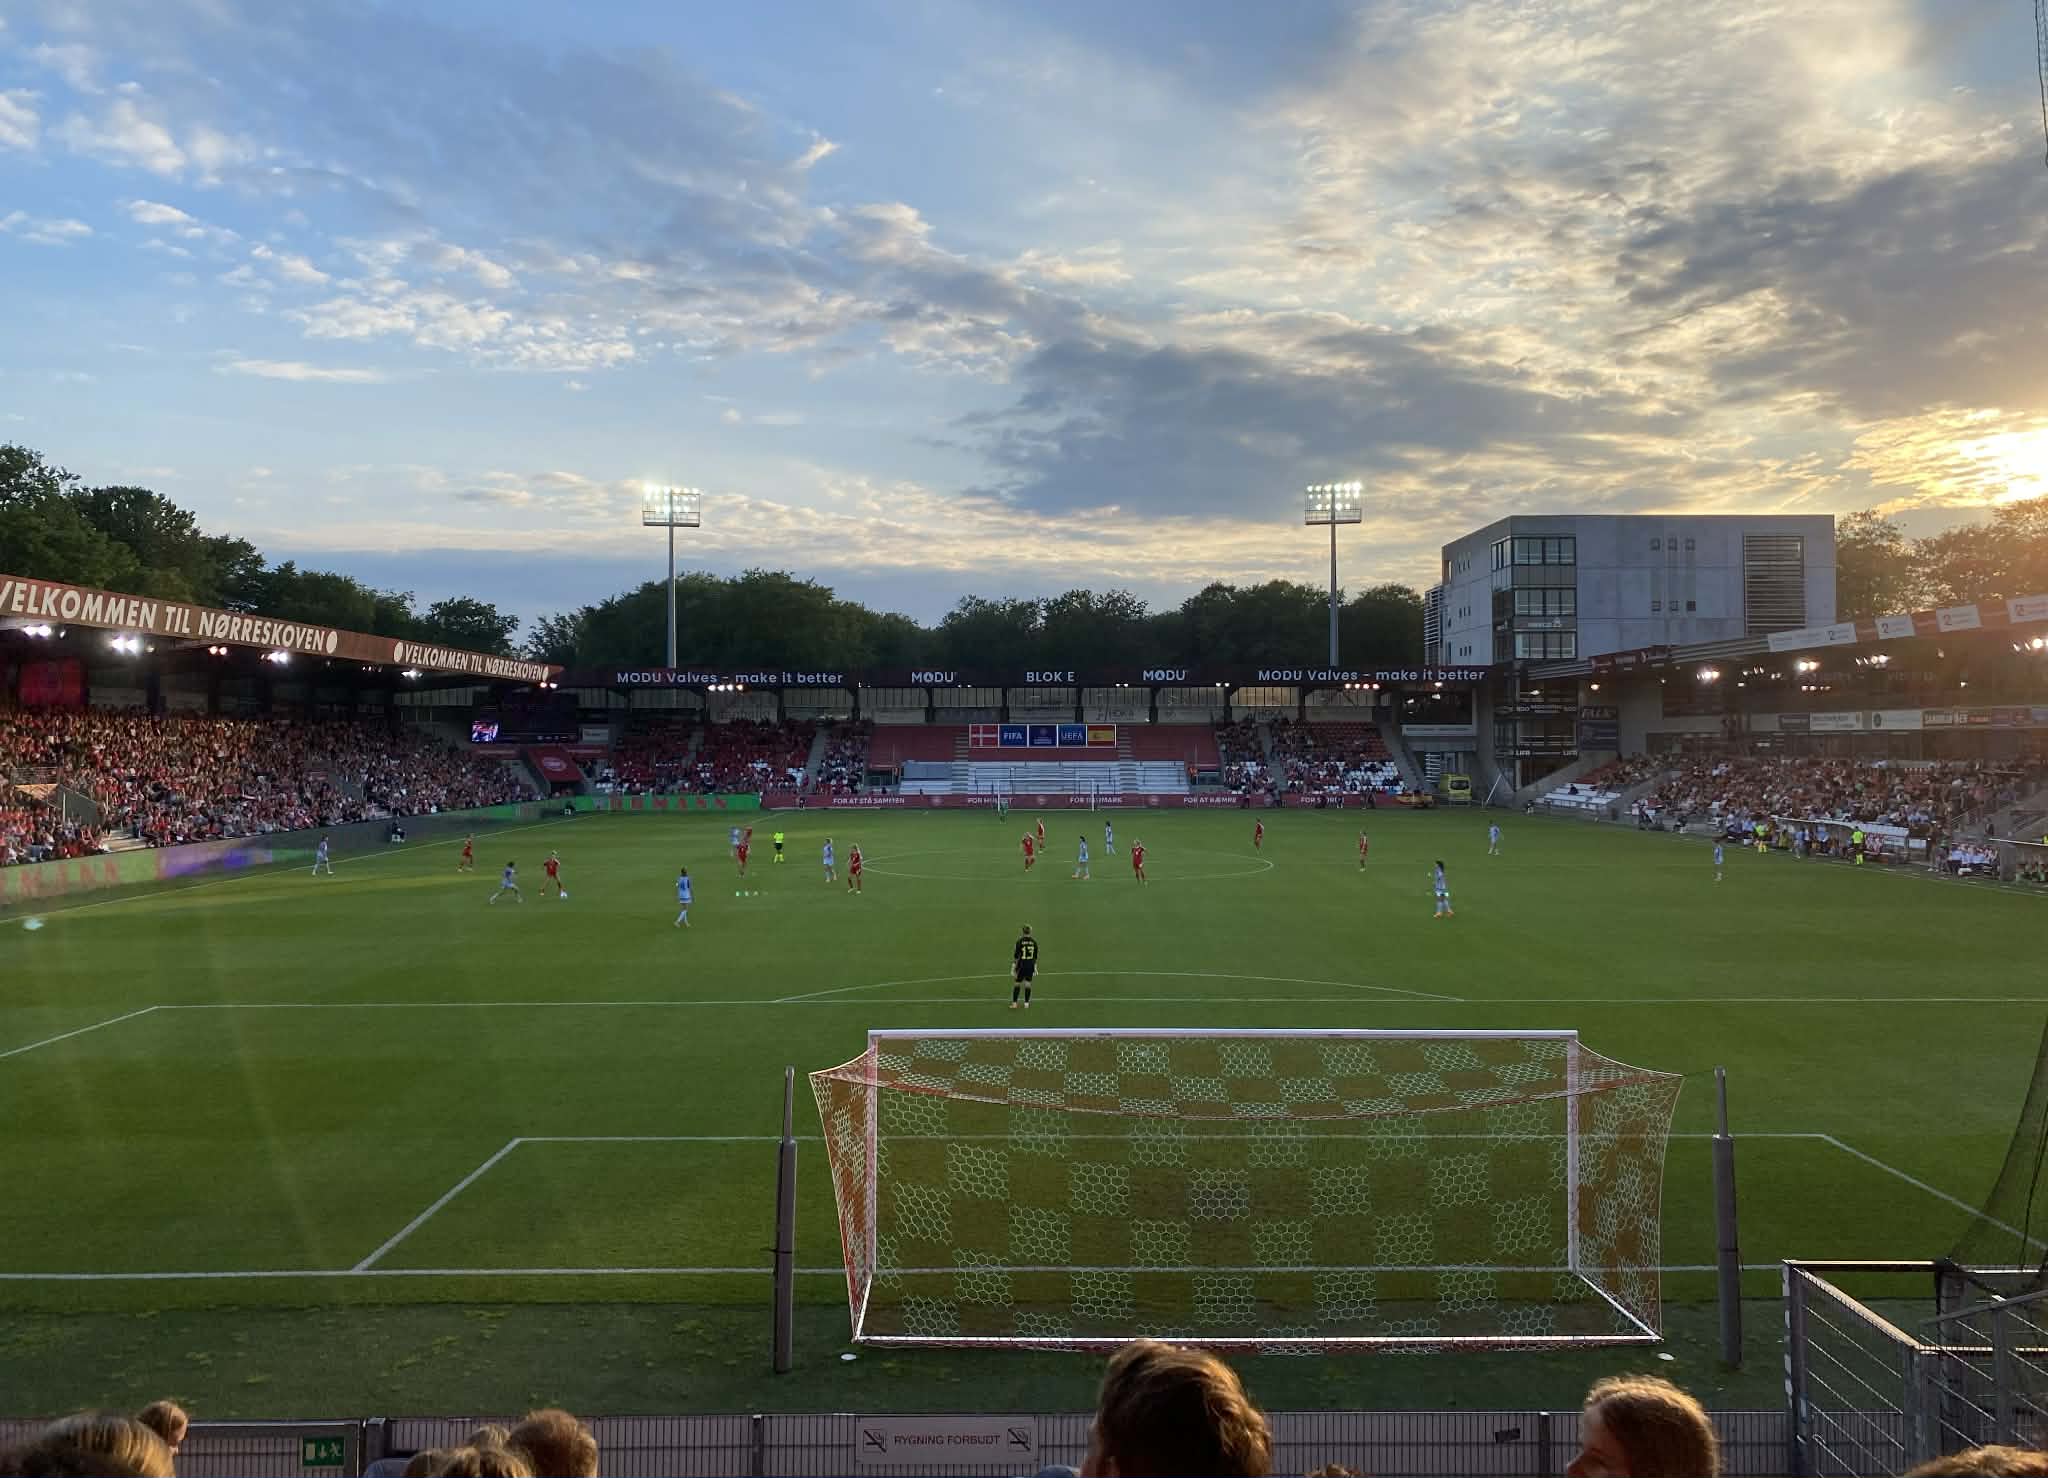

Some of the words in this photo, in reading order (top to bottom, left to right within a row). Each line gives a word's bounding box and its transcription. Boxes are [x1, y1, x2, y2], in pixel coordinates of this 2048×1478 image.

[165, 605, 191, 634] TIL
[198, 611, 325, 652] NØRRESKOVEN
[405, 643, 469, 671] VELKOMMEN
[470, 655, 483, 672] TIL
[485, 657, 544, 681] NØRRESKOVEN
[616, 672, 661, 683] MODU
[667, 672, 718, 683] Valves
[735, 671, 777, 683] make
[782, 671, 792, 683] it
[797, 671, 843, 683] better
[911, 671, 955, 683] MODU
[1026, 671, 1062, 682] BLOK
[1068, 672, 1075, 682] E
[1143, 670, 1186, 681] MODU
[1258, 670, 1302, 681] MODU
[1307, 670, 1358, 681] Valves
[1375, 669, 1417, 681] make
[1422, 669, 1433, 681] it
[1438, 669, 1485, 681] better
[1003, 732, 1023, 740] FIFA
[1061, 731, 1083, 741] UEFA
[1021, 946, 1035, 960] 13
[894, 1434, 944, 1445] RYGNING
[948, 1434, 1001, 1445] FORBUDT
